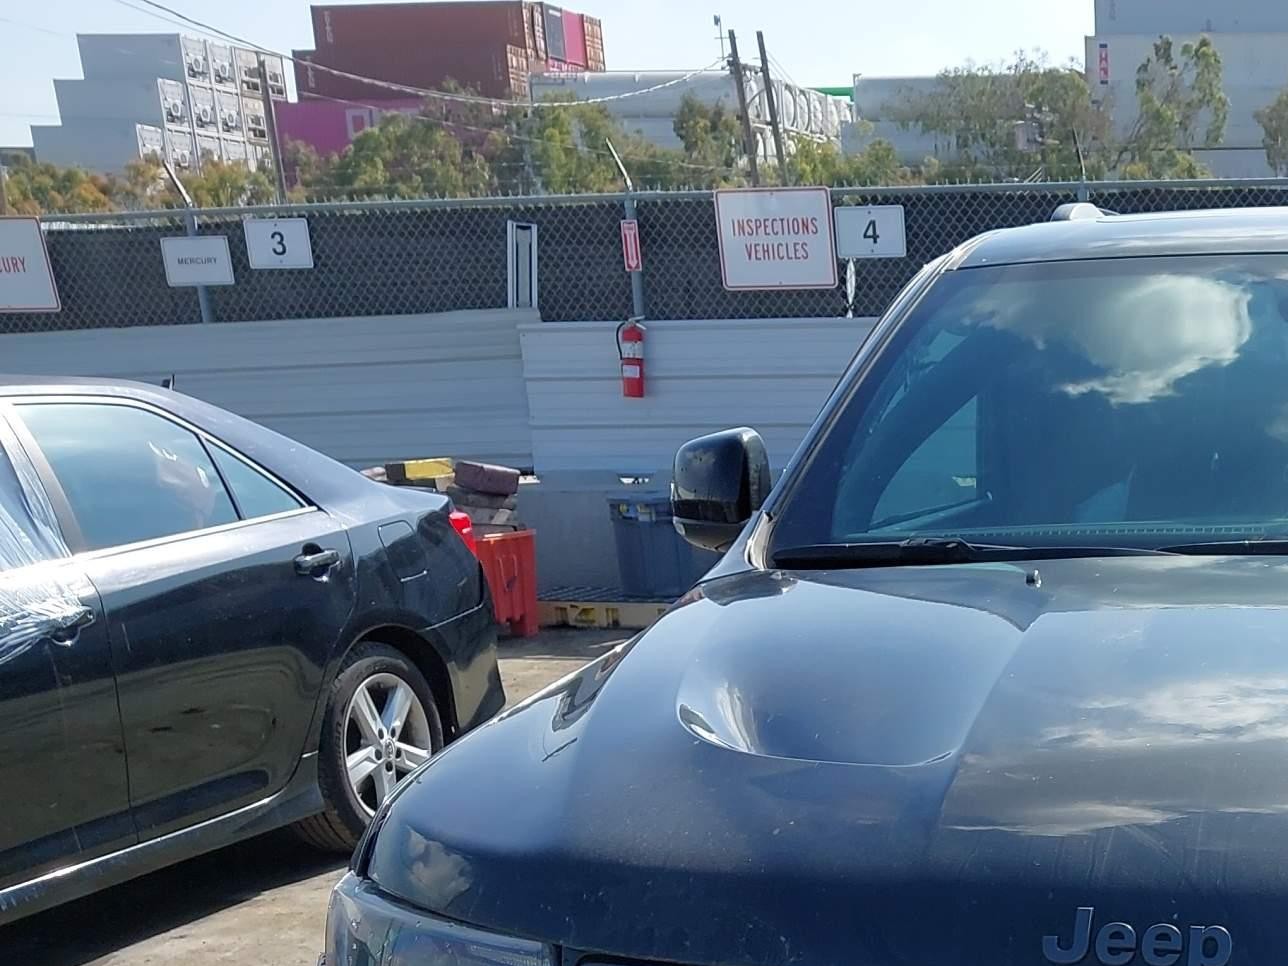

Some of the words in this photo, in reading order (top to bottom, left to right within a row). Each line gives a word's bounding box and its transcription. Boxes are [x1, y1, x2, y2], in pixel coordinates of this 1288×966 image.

[731, 216, 819, 237] INSPECTIONS
[862, 219, 880, 244] 4
[270, 231, 287, 256] 3
[744, 242, 809, 261] VEHICLES
[0, 256, 27, 273] URY
[177, 256, 218, 266] MERCURY
